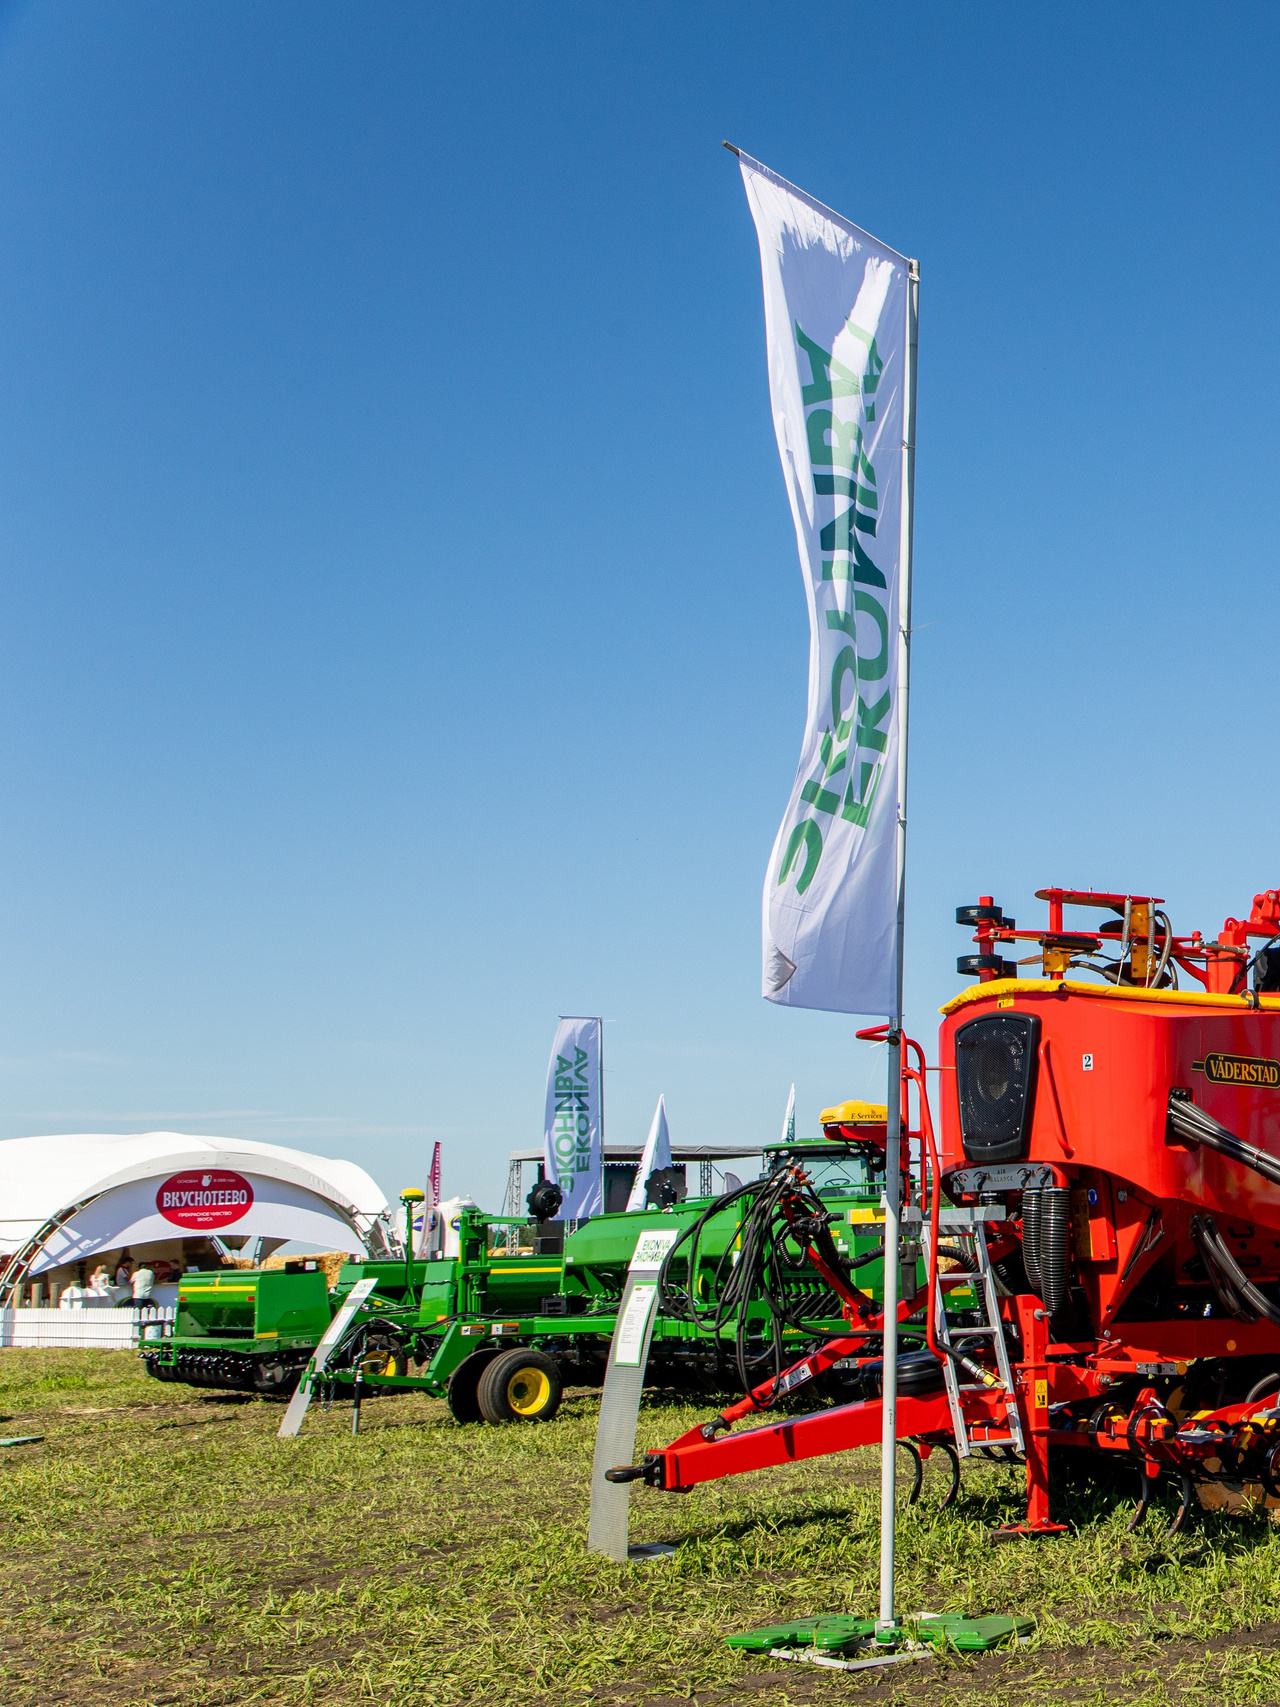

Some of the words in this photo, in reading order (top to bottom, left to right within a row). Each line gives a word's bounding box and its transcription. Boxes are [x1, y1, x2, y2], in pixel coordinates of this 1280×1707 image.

[1084, 1055, 1091, 1067] 2
[1210, 1056, 1278, 1083] VÄDERSTAD
[163, 1190, 247, 1207] ВКУСНОТЕЕВО
[642, 1239, 671, 1251] EKONIVA
[634, 1251, 664, 1262] ЭКОНИВА
